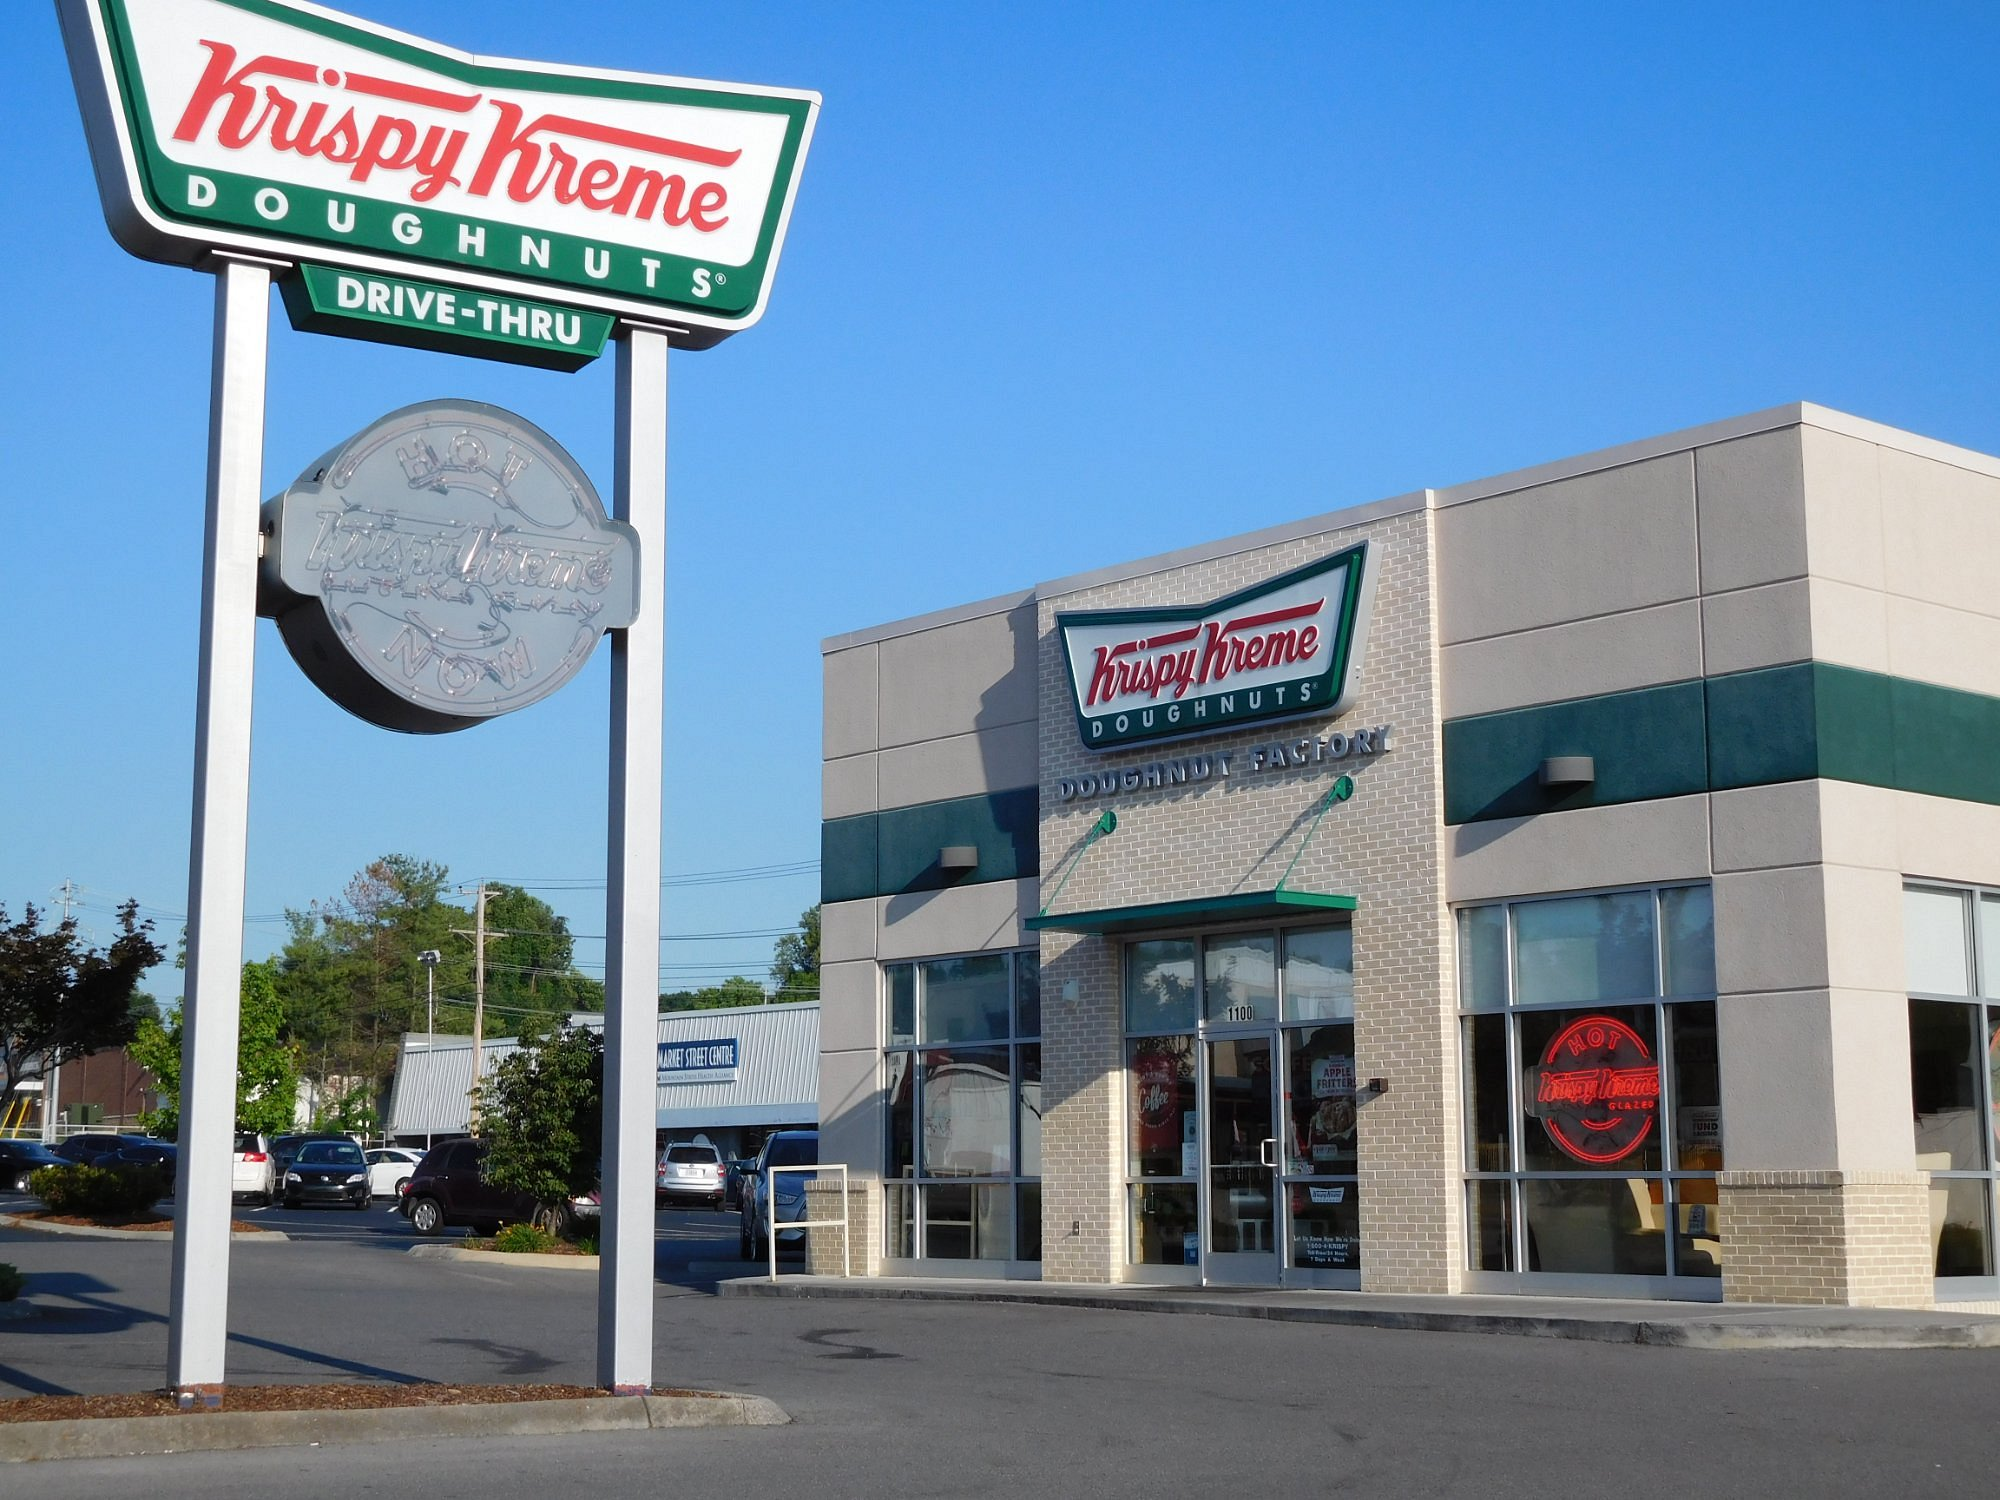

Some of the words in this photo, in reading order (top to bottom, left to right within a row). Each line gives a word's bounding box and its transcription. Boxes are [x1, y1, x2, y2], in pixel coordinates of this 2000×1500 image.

[171, 39, 483, 202] Krispy
[467, 98, 743, 234] Kreme
[336, 275, 582, 346] DRIVE-THRU
[395, 430, 533, 489] HOT
[382, 625, 537, 697] NOW
[1085, 622, 1203, 706] Krispy
[1197, 596, 1326, 685] Kreme
[1057, 751, 1234, 801] DOUGHNUT
[1249, 724, 1394, 771] FACTORY
[1227, 1005, 1253, 1021] 1100
[657, 1048, 685, 1069] MARKET
[685, 1046, 709, 1067] STREET
[709, 1044, 734, 1066] CENTRE
[1567, 1026, 1622, 1057] HOT
[1323, 1067, 1351, 1077] APPLE
[1537, 1069, 1600, 1105] Krispy
[1599, 1066, 1660, 1100] Kreme
[1138, 1084, 1169, 1113] Coffee
[1608, 1100, 1655, 1111] GLAZED
